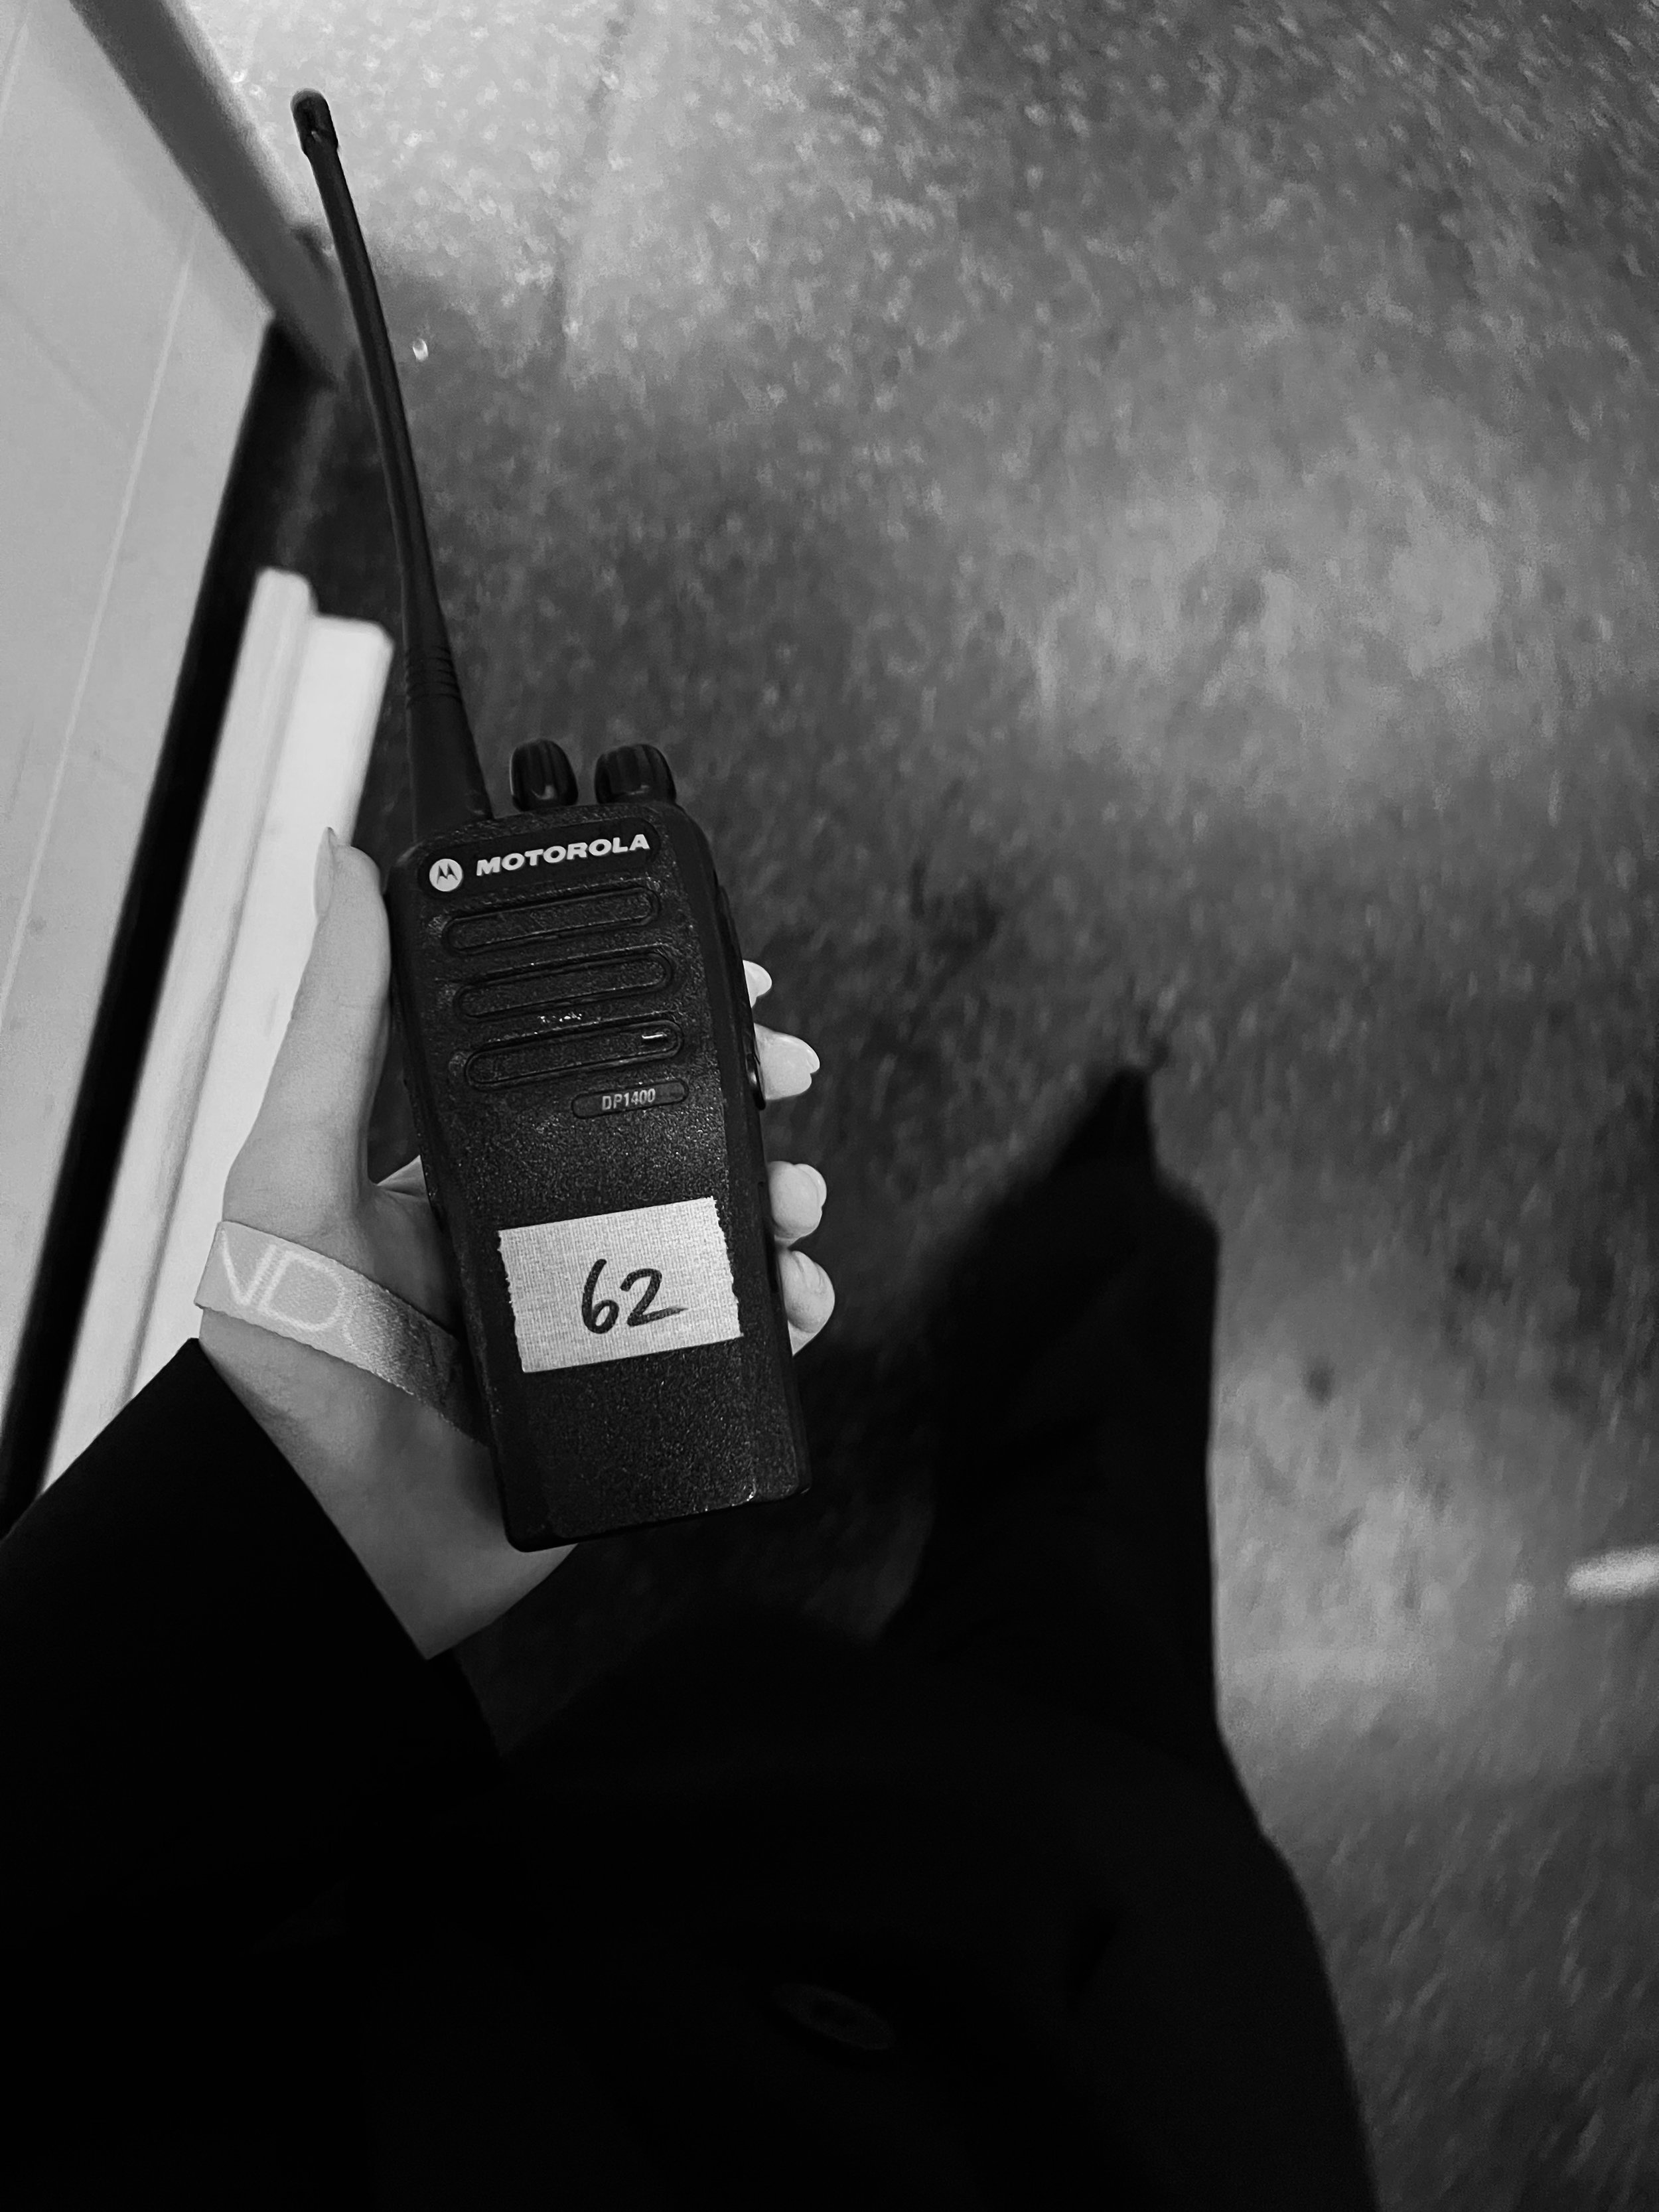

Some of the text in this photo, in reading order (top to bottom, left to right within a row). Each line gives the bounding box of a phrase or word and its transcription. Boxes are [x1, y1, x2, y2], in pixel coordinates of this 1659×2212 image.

[476, 834, 650, 876] MOTOROLA
[602, 1088, 656, 1110] DP1400
[581, 1258, 688, 1334] 62
